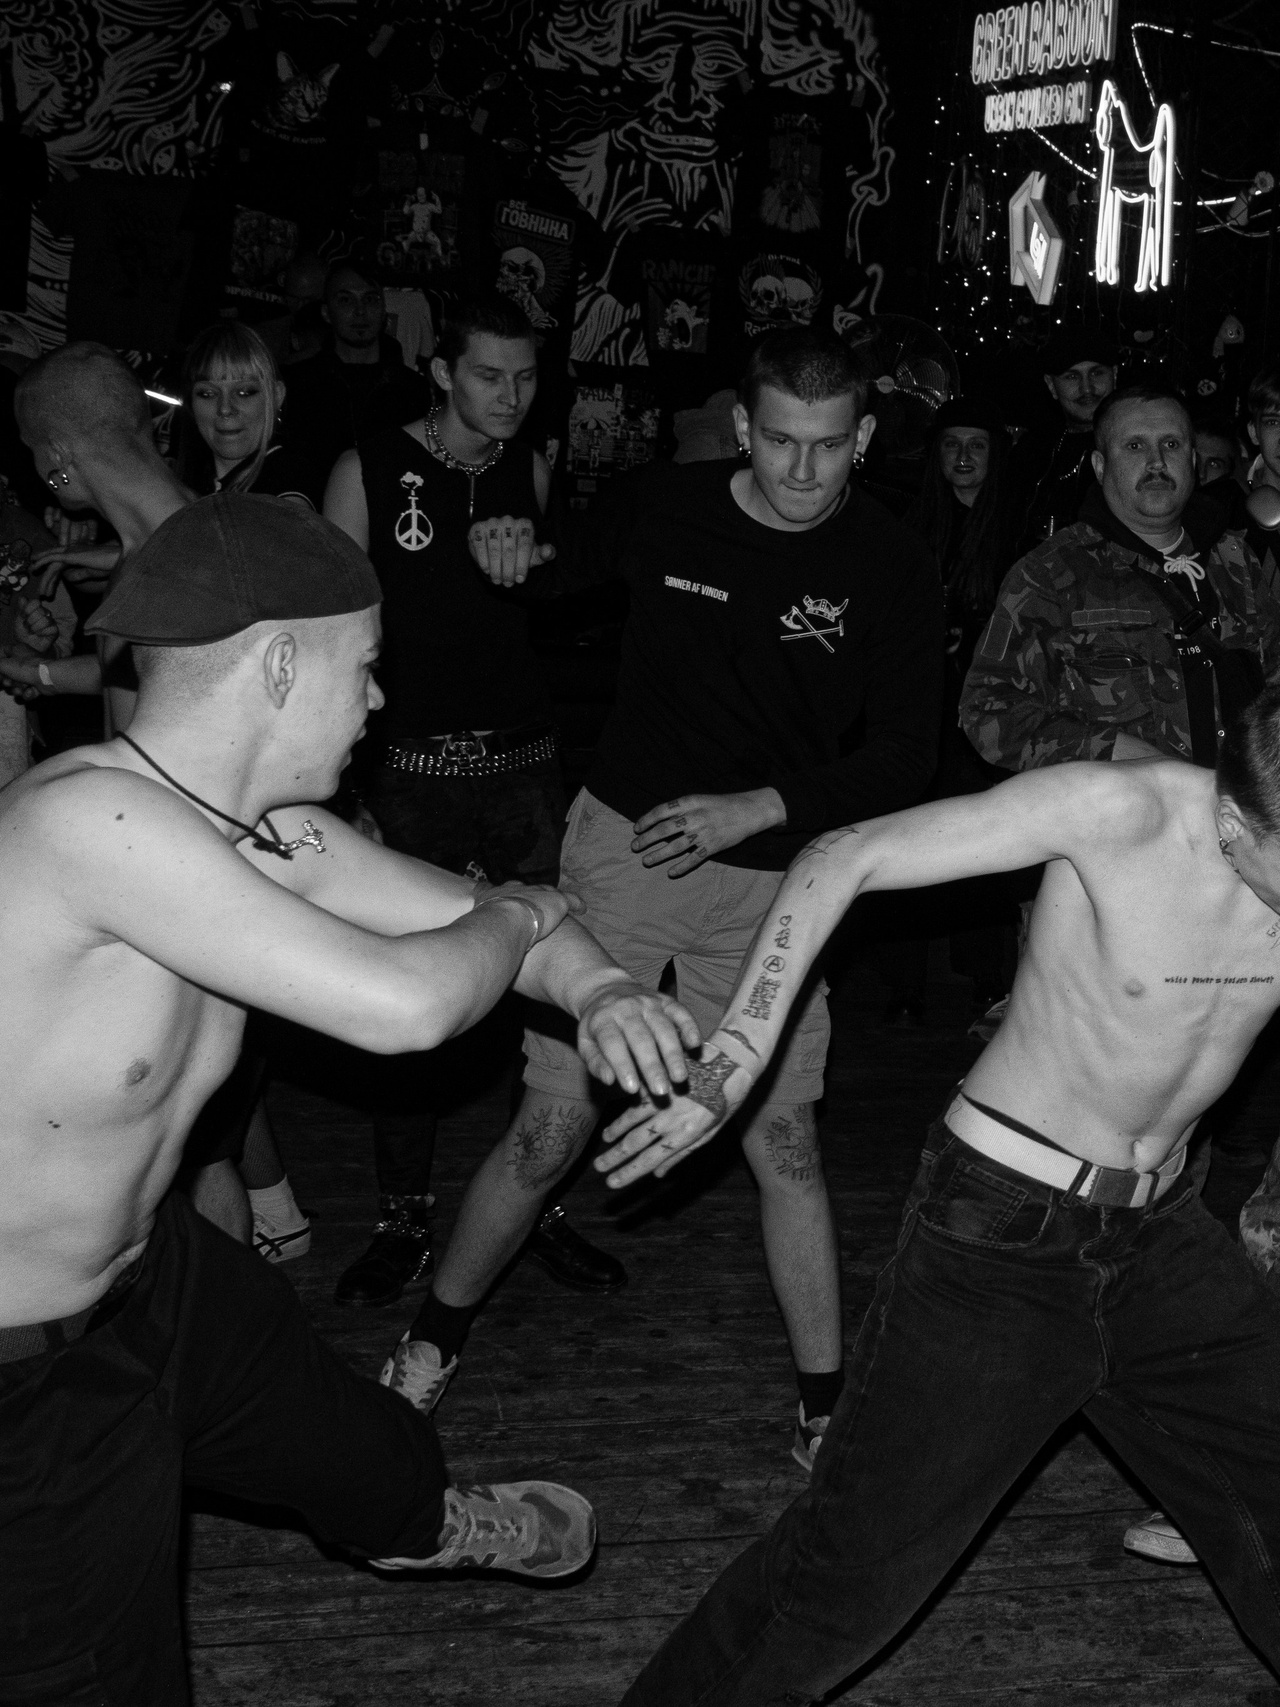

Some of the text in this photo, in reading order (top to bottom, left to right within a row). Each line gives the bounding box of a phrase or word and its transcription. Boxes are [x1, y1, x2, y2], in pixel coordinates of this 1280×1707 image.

[972, 0, 1114, 85] GREEN BABOON
[501, 207, 570, 240] ГОВНИНА
[641, 258, 717, 284] RANCID
[664, 575, 729, 602] SØNNER AF VINDEN
[1187, 645, 1202, 655] 198
[1192, 976, 1214, 985] power
